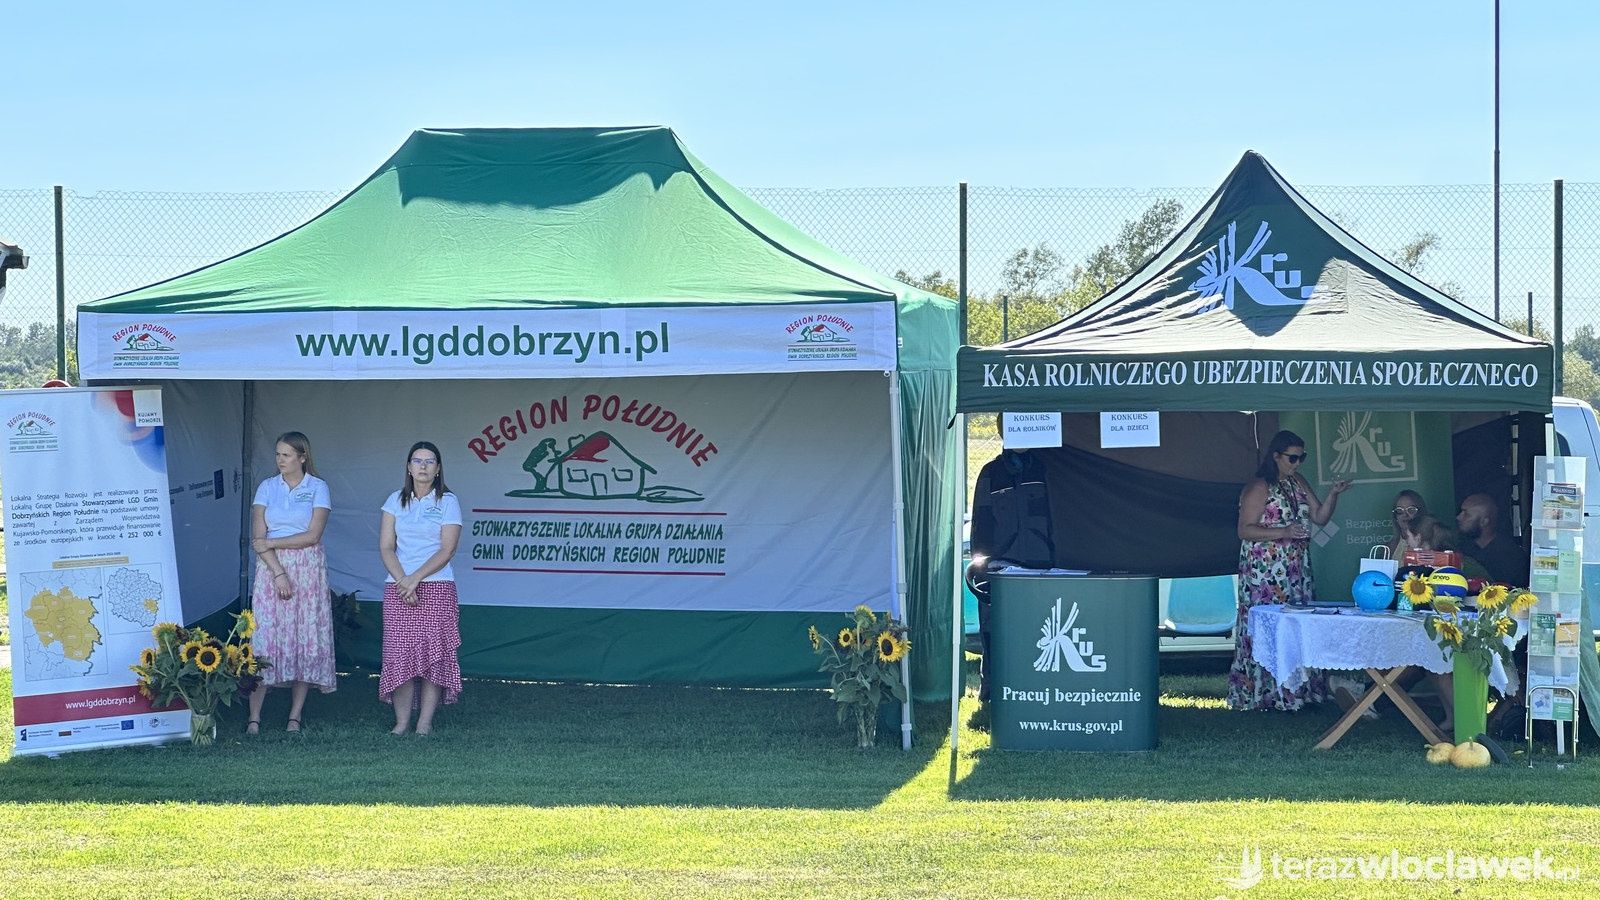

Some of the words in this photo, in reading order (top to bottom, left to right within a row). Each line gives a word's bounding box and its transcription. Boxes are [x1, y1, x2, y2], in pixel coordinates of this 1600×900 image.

[785, 315, 814, 334] REGION
[816, 314, 854, 333] POŁUDNIE
[112, 324, 140, 342] REGION
[142, 323, 177, 342] POŁUDNIE
[296, 322, 669, 365] www.lgddobrzyn.pl
[982, 362, 1039, 388] KASA
[1045, 361, 1187, 388] ROLNICZEGO
[1193, 360, 1366, 387] UBEZPIECZENIA
[1371, 361, 1539, 389] SPOŁECZNEGO
[7, 413, 26, 428] REGION
[1014, 414, 1050, 422] KONKURS
[1111, 413, 1148, 422] KONKURS
[467, 395, 568, 463] REGION
[582, 394, 718, 467] POŁUDNIE
[1023, 424, 1056, 432] ROLNIKÓW
[1110, 425, 1124, 433] DLA
[1126, 424, 1150, 432] DZIECI
[1329, 410, 1406, 473] Krus
[144, 488, 158, 496] przez
[82, 498, 124, 507] Stowarzyszenie
[12, 511, 50, 520] Dobrzyńskich
[74, 508, 100, 516] Południe
[110, 506, 138, 515] podstawie
[76, 518, 104, 526] Zarządem
[122, 514, 160, 522] Województwa
[13, 528, 78, 538] Kujawsko-Pomorskiego,
[80, 526, 94, 534] która
[96, 525, 124, 533] przewiduje
[127, 522, 161, 530] finansowanie
[472, 520, 570, 539] STOWARZYSZENIE
[573, 522, 622, 540] LOKALNA
[625, 523, 662, 540] GRUPA
[664, 523, 724, 540] DZIAŁANIA
[24, 538, 47, 546] środków
[50, 536, 84, 545] europejskich
[472, 543, 504, 560] GMIN
[512, 541, 606, 562] DOBRZYŃSKICH
[613, 546, 659, 564] REGION
[667, 546, 726, 564] POŁUDNIE
[1033, 597, 1107, 672] Krus
[65, 695, 136, 710] www.lgddobrzyn.pl
[1002, 687, 1050, 705] Pracuj
[1055, 688, 1142, 706] bezpiecznie
[1019, 719, 1123, 734] www.krus.gov.pl
